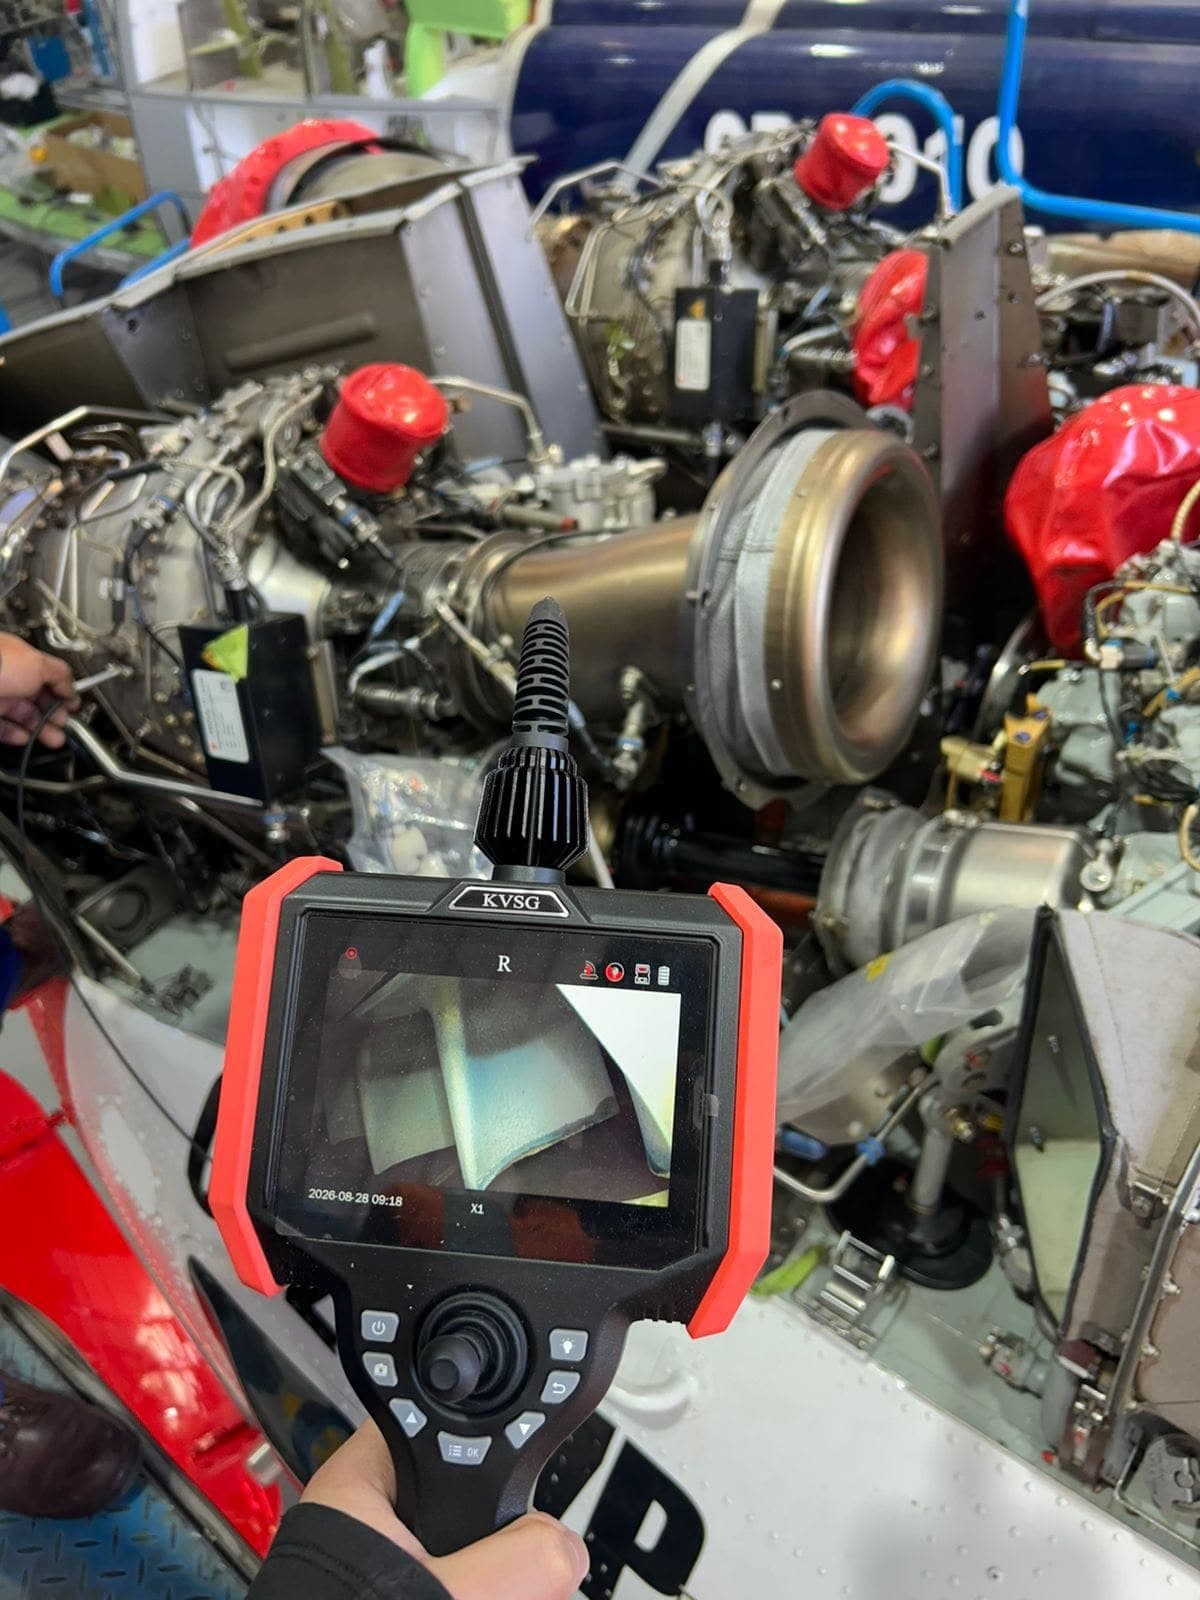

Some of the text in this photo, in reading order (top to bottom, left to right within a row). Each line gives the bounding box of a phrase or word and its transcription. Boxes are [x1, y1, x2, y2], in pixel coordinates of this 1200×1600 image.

[482, 893, 541, 910] KVSG
[496, 954, 512, 973] R
[308, 1188, 403, 1207] 2026-08-28 09:18
[470, 1203, 484, 1215] X1
[467, 1447, 479, 1458] OK
